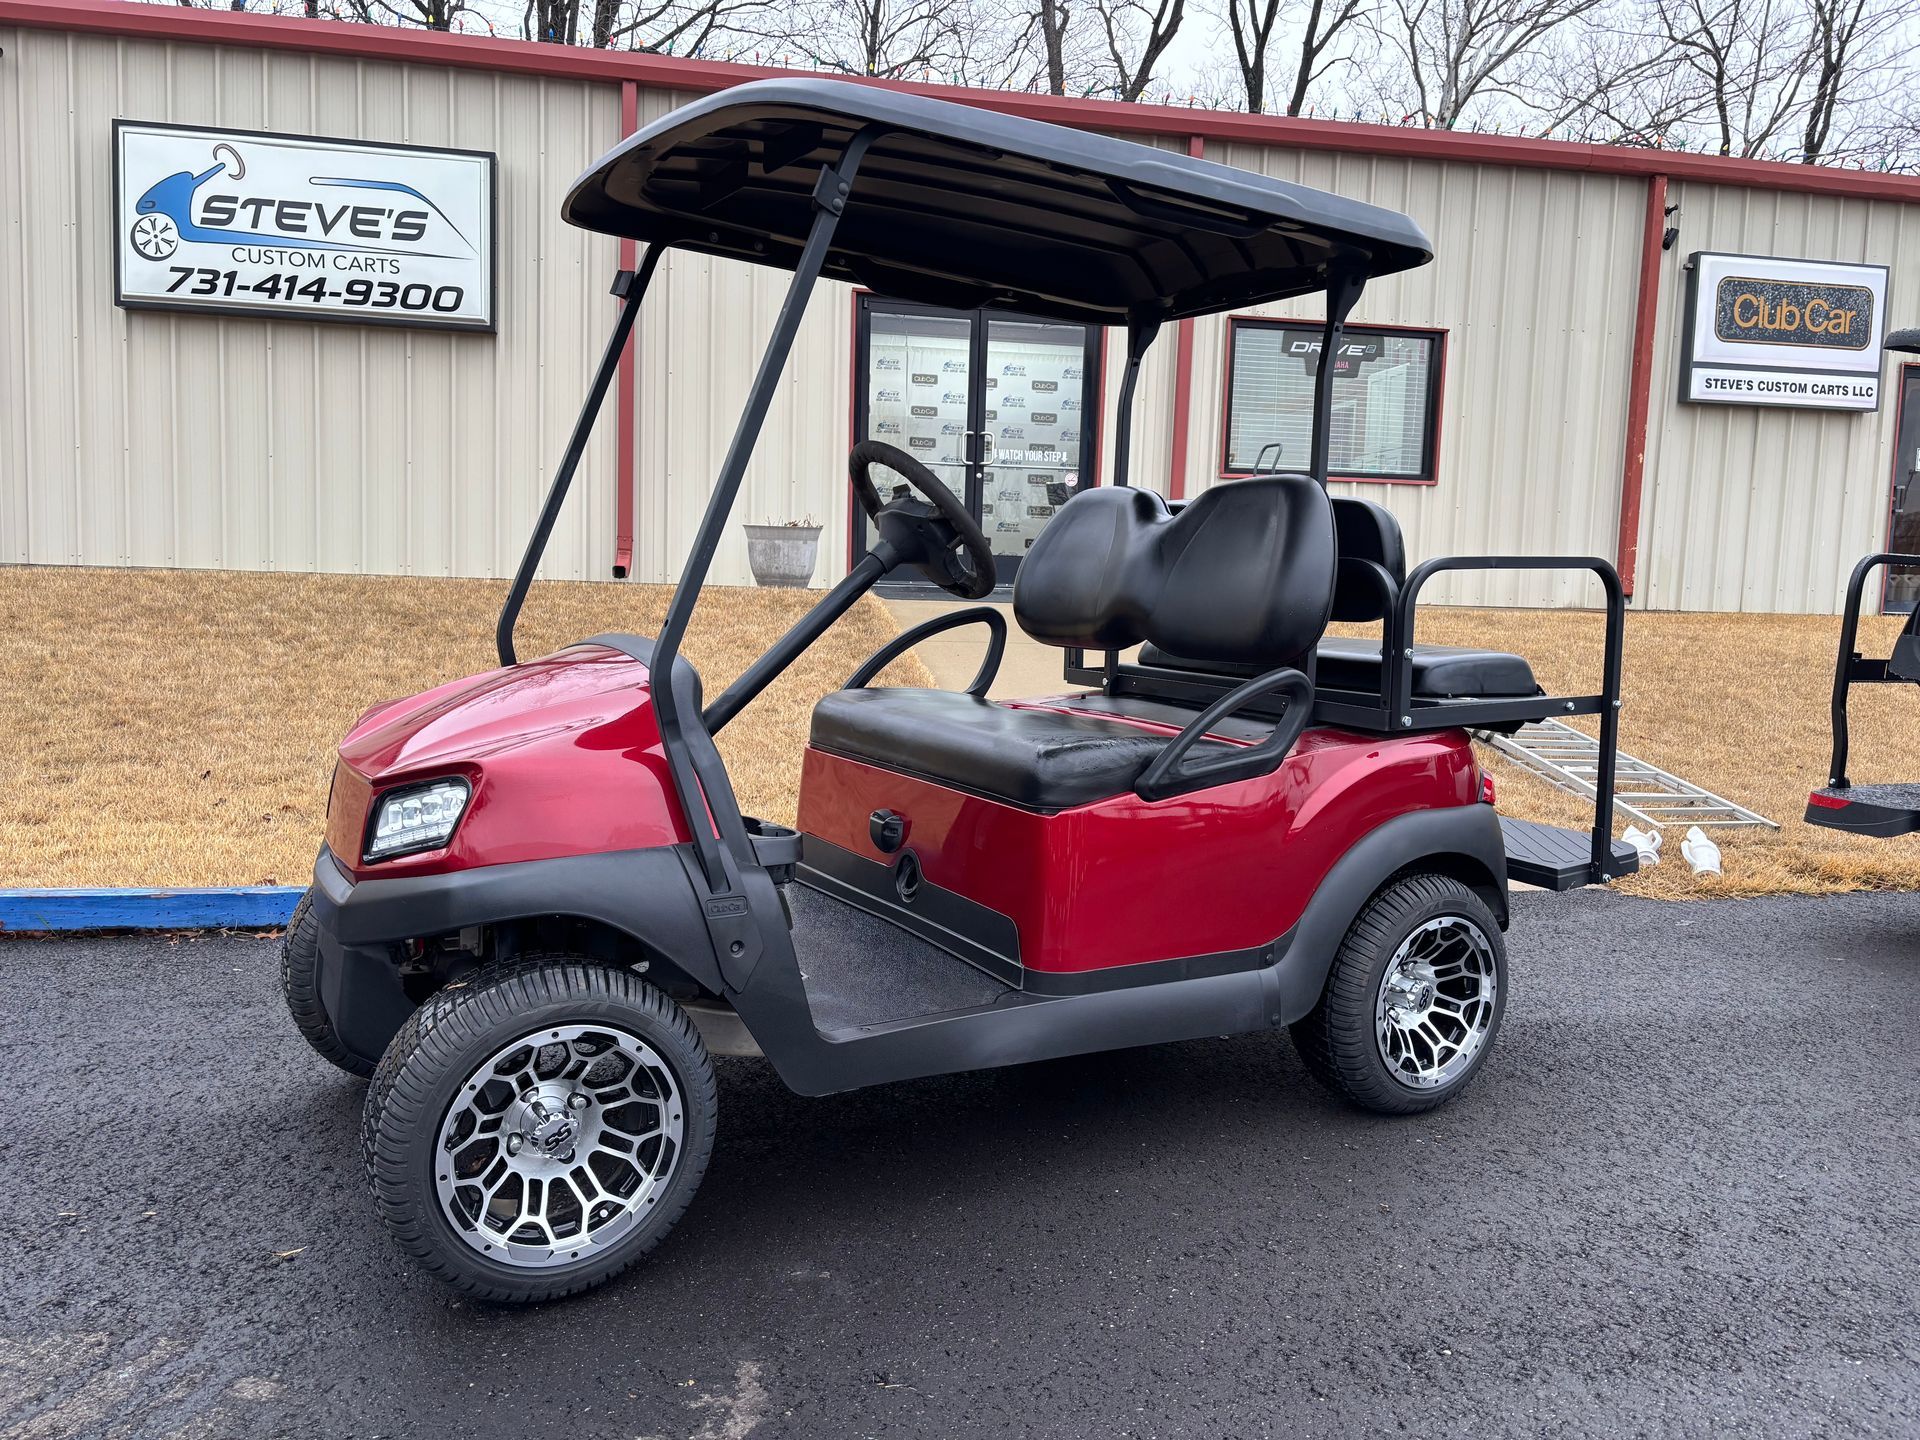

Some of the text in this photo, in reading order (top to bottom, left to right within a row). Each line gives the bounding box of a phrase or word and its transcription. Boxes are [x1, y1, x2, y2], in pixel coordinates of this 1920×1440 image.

[200, 194, 429, 241] STEVE'S
[231, 247, 401, 274] CUSTOM CARTS
[165, 266, 465, 312] 731-414-9300
[1733, 293, 1857, 334] Club Car
[1705, 377, 1874, 398] STEVE'S CUSTOM CARTS LLC
[998, 448, 1023, 461] WATCH
[1024, 450, 1043, 462] YOUR
[1043, 451, 1062, 463] STEP
